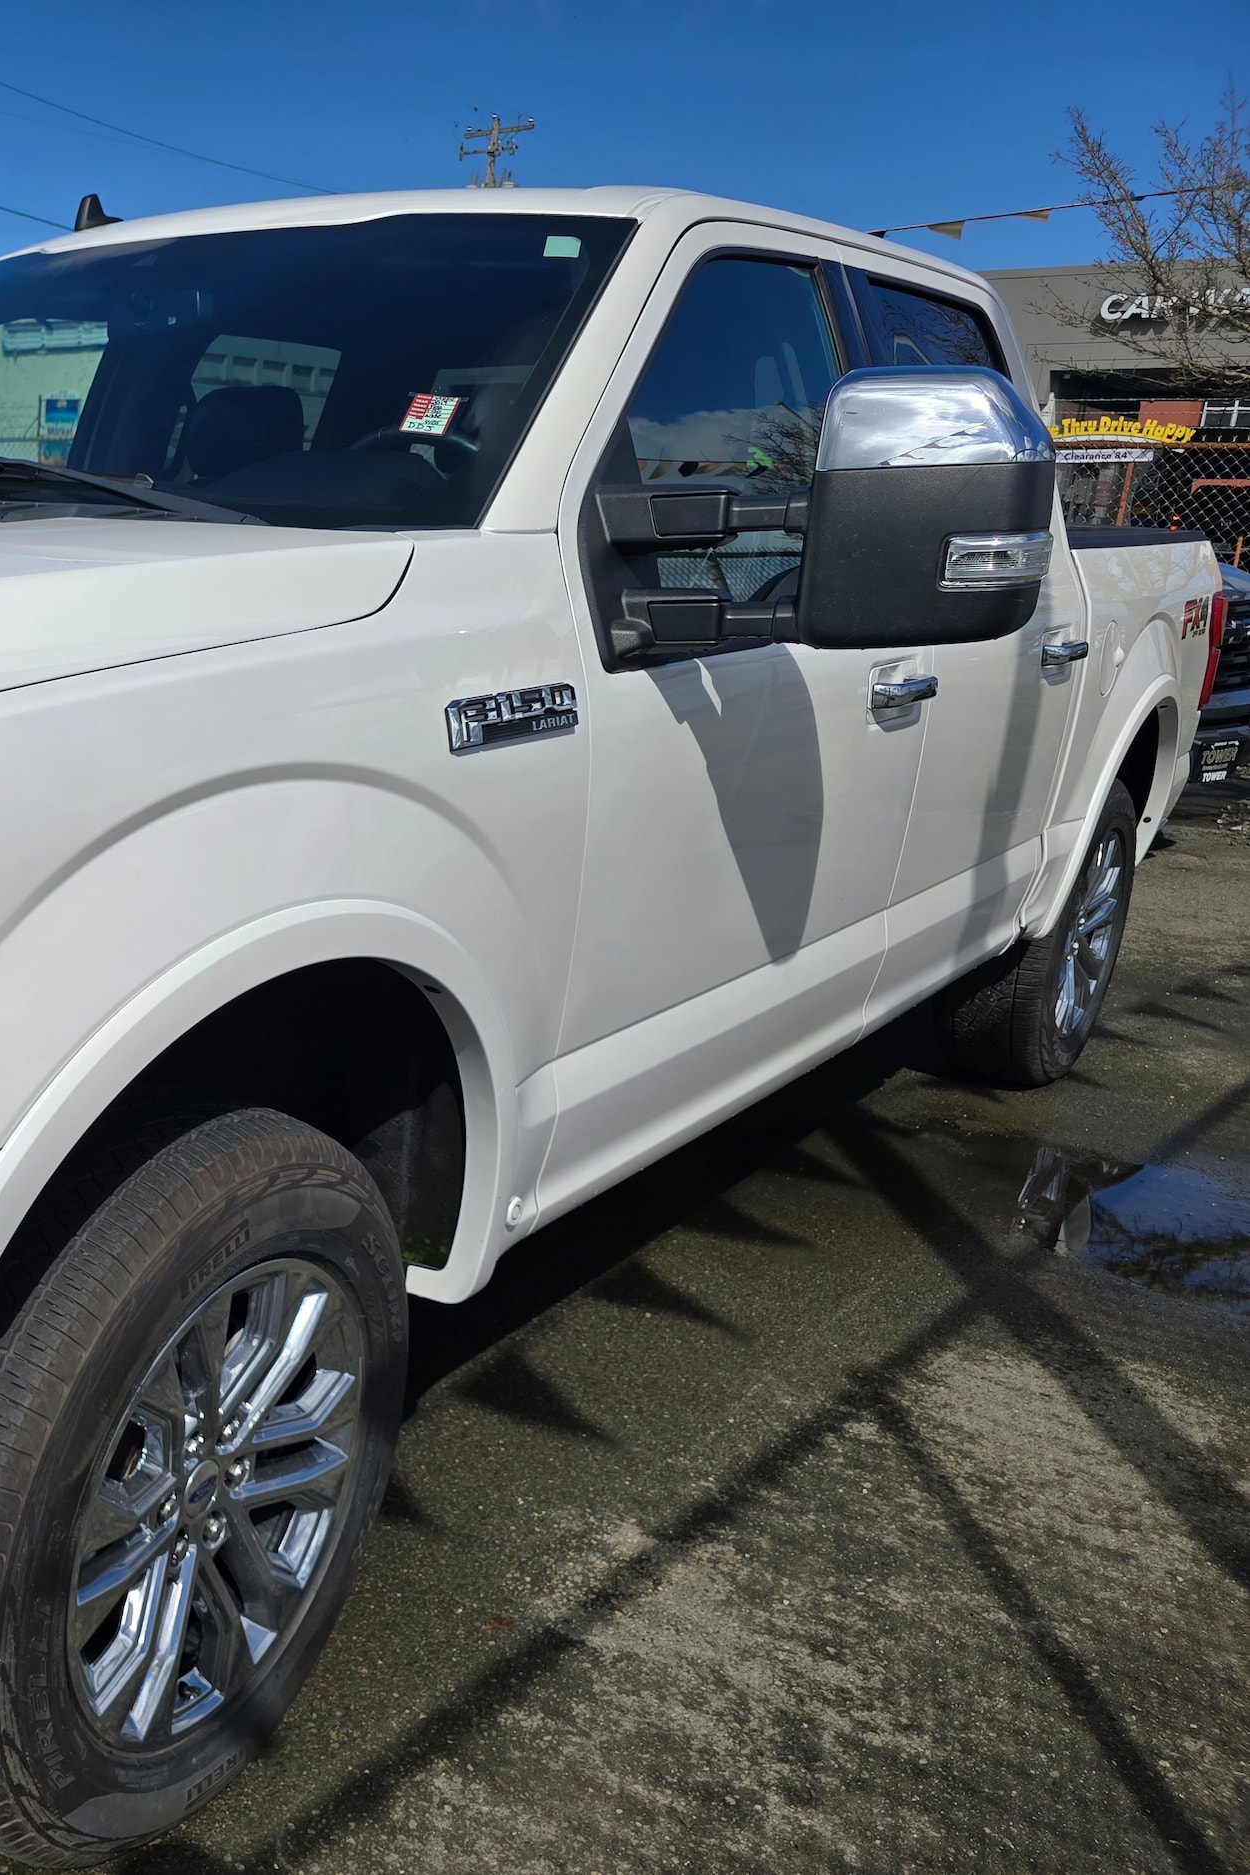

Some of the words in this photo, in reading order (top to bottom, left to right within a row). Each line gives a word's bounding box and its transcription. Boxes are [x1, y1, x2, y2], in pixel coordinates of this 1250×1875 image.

[1100, 292, 1178, 321] CAR
[1061, 418, 1098, 435] Thru
[1099, 416, 1141, 435] Drive
[1142, 419, 1196, 443] Happy
[1064, 450, 1112, 461] Clearance
[1181, 596, 1210, 640] FX4
[532, 713, 575, 731] LARIAT
[1201, 747, 1238, 765] TOWER
[1202, 771, 1228, 783] TOWER
[29, 1597, 77, 1790] PIRELLI
